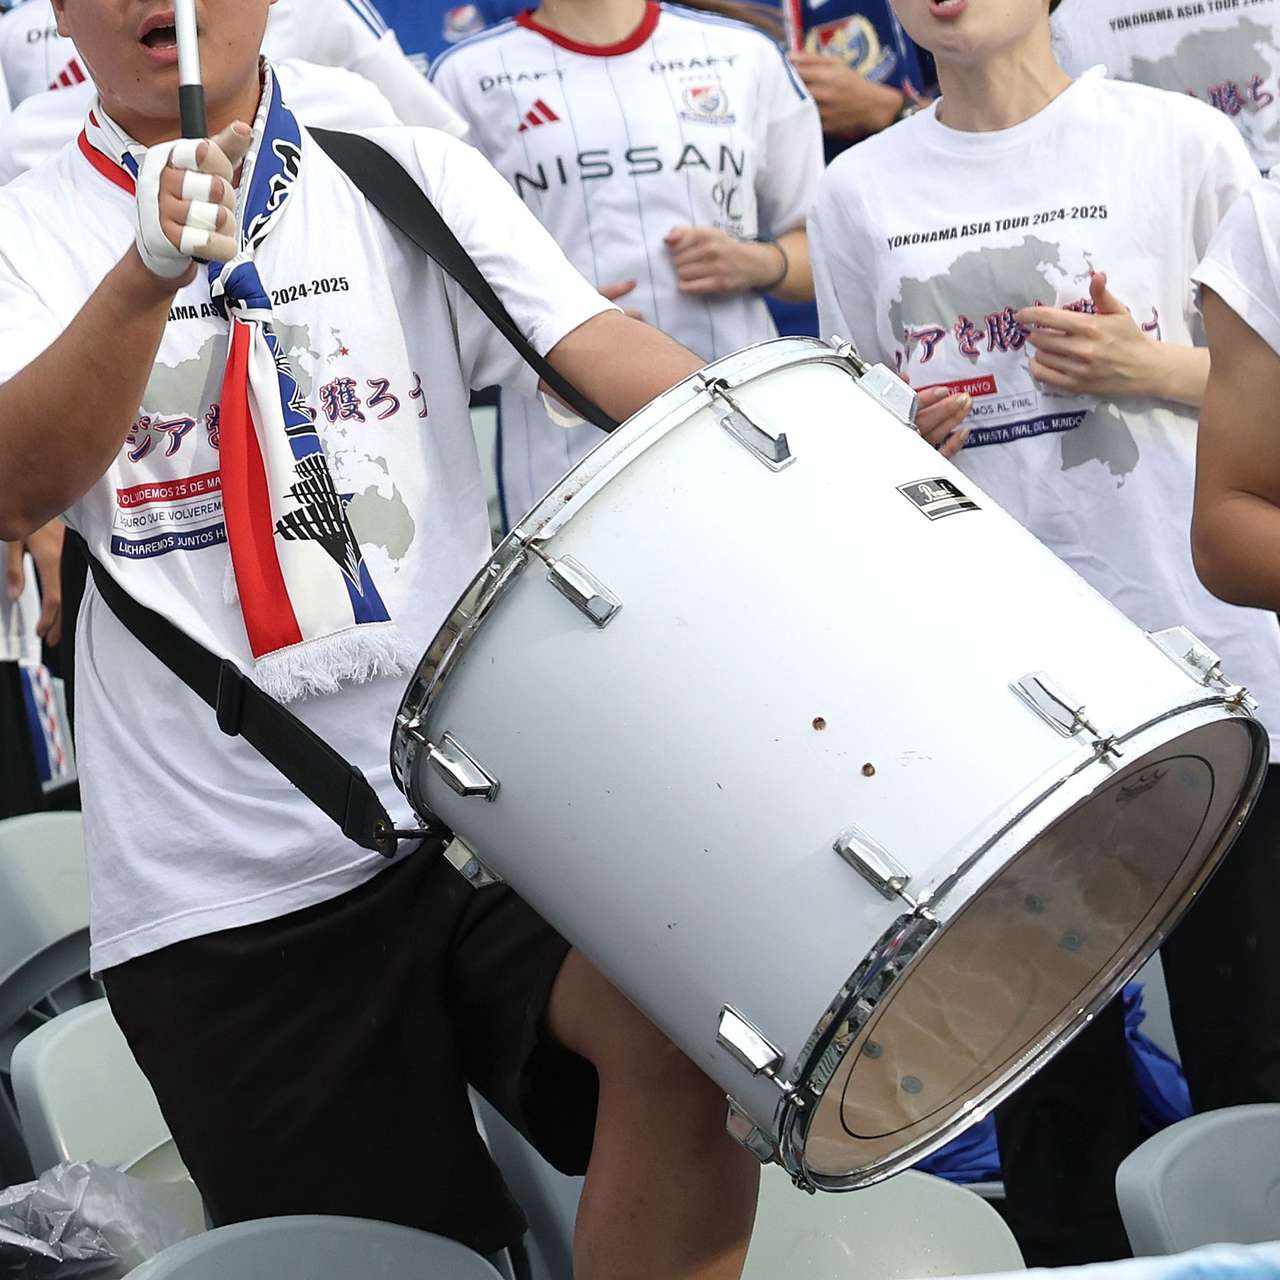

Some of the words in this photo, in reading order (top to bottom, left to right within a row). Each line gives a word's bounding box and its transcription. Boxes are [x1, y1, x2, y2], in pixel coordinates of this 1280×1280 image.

[1109, 6, 1174, 32] YOKOHAMA
[1178, 1, 1205, 18] ASIA
[514, 144, 745, 200] NISSAN
[887, 227, 958, 251] YOKOHAMA
[961, 221, 991, 237] ASIA
[994, 216, 1030, 232] TOUR
[1033, 205, 1108, 225] 2024-2025
[272, 276, 349, 306] 2024-2025
[190, 480, 204, 492] DE
[207, 476, 221, 488] MA
[148, 511, 165, 524] QUE
[168, 501, 223, 521] VOLVEREM
[177, 532, 213, 547] JUNTOS
